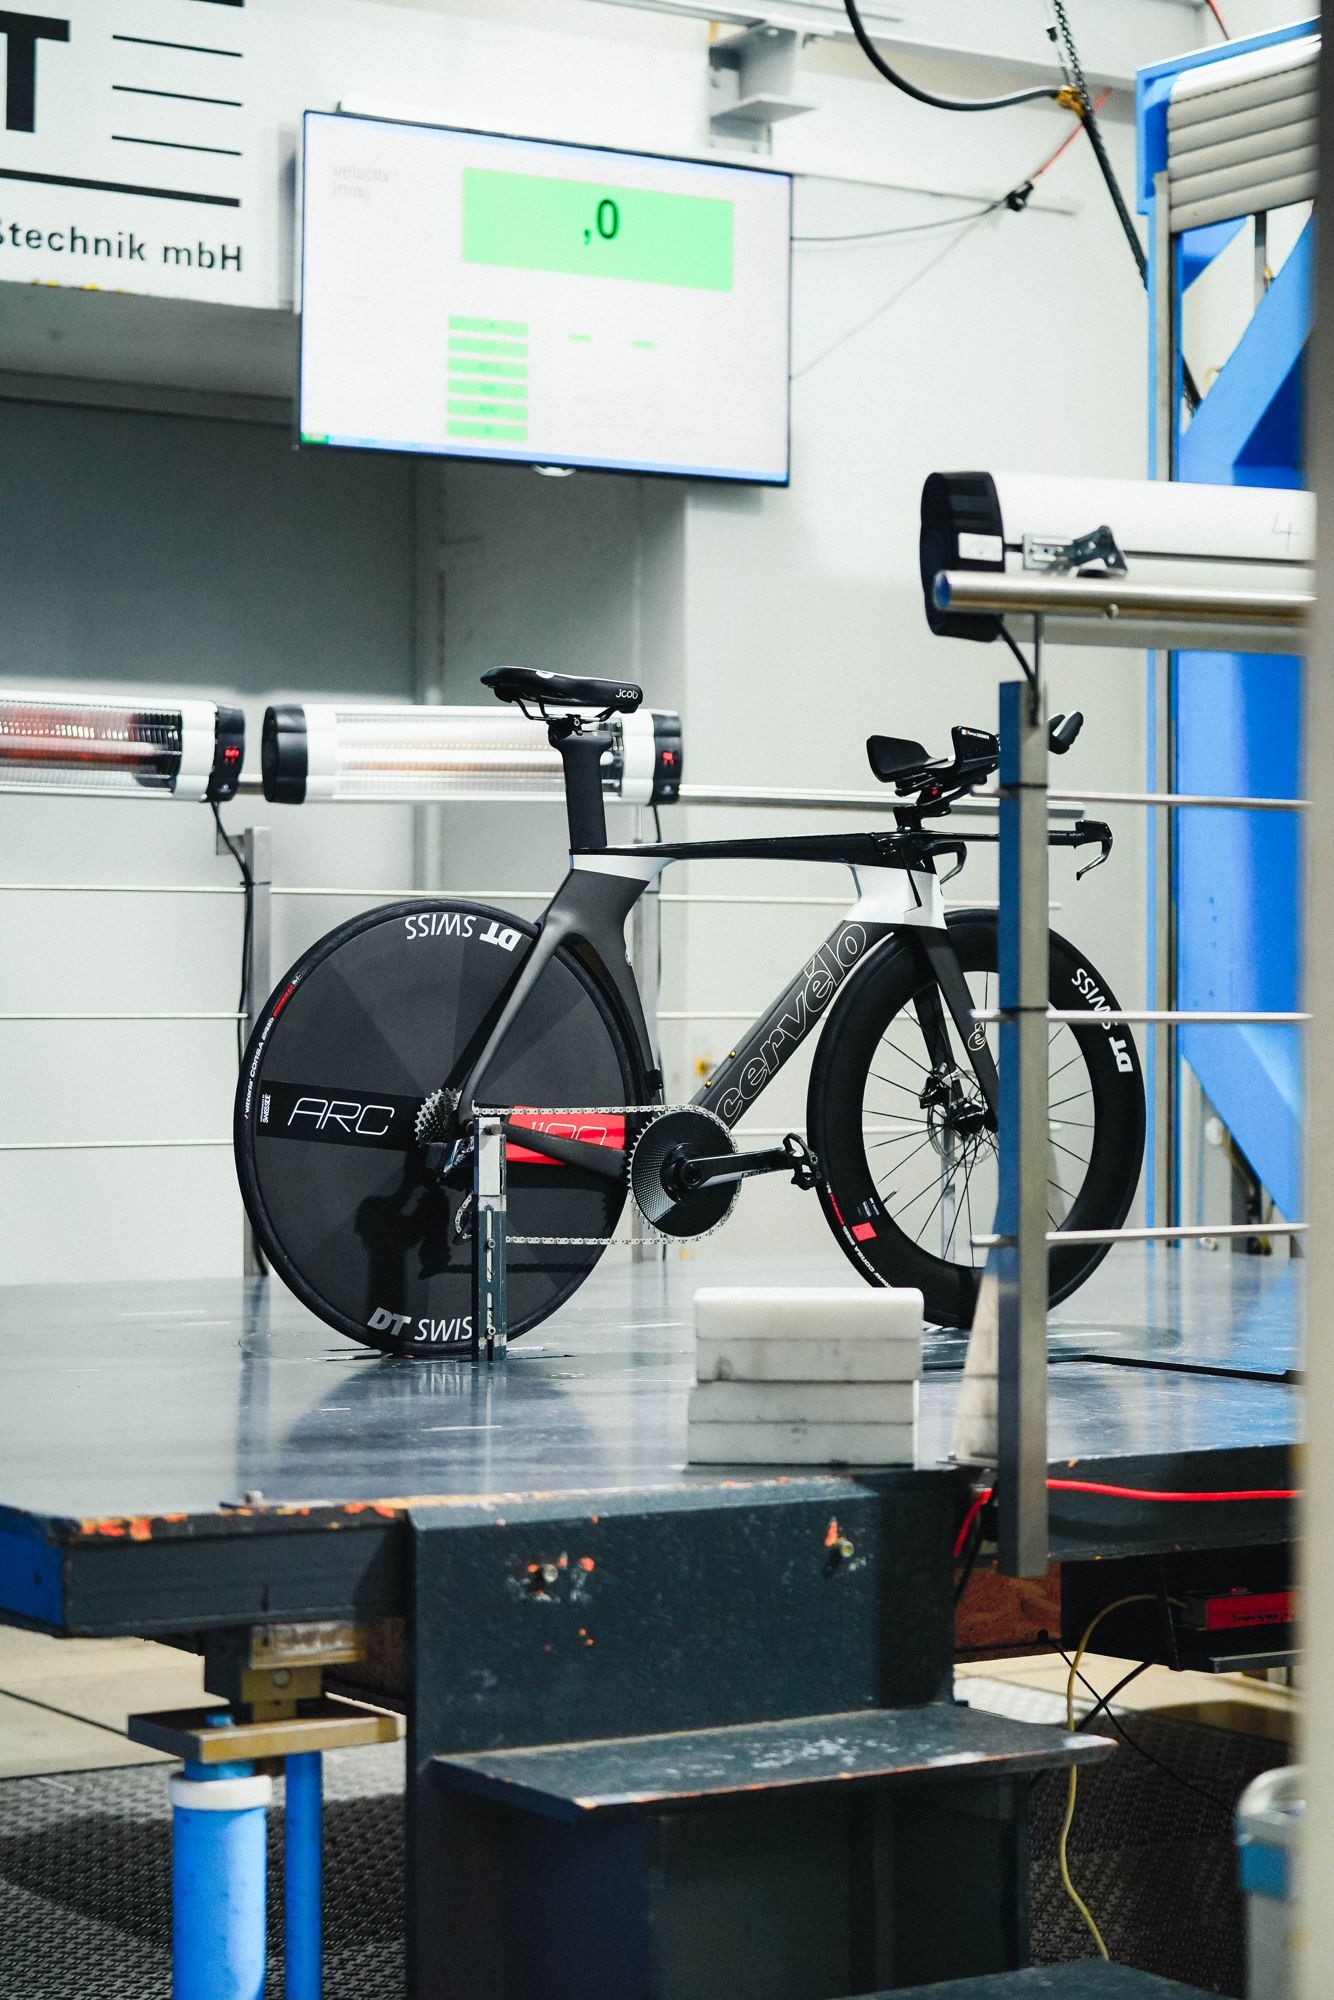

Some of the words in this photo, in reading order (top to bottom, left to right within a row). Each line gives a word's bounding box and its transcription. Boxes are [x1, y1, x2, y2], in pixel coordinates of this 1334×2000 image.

[163, 242, 242, 272] mbH
[1272, 511, 1301, 552] 4
[404, 913, 477, 940] SWISS
[479, 921, 523, 952] DT
[715, 923, 867, 1129] cervélo
[250, 1041, 265, 1078] CORSA
[1108, 1036, 1134, 1073] DT
[287, 1097, 395, 1136] ARC
[366, 1306, 412, 1336] DT
[414, 1315, 473, 1342] SWIS
